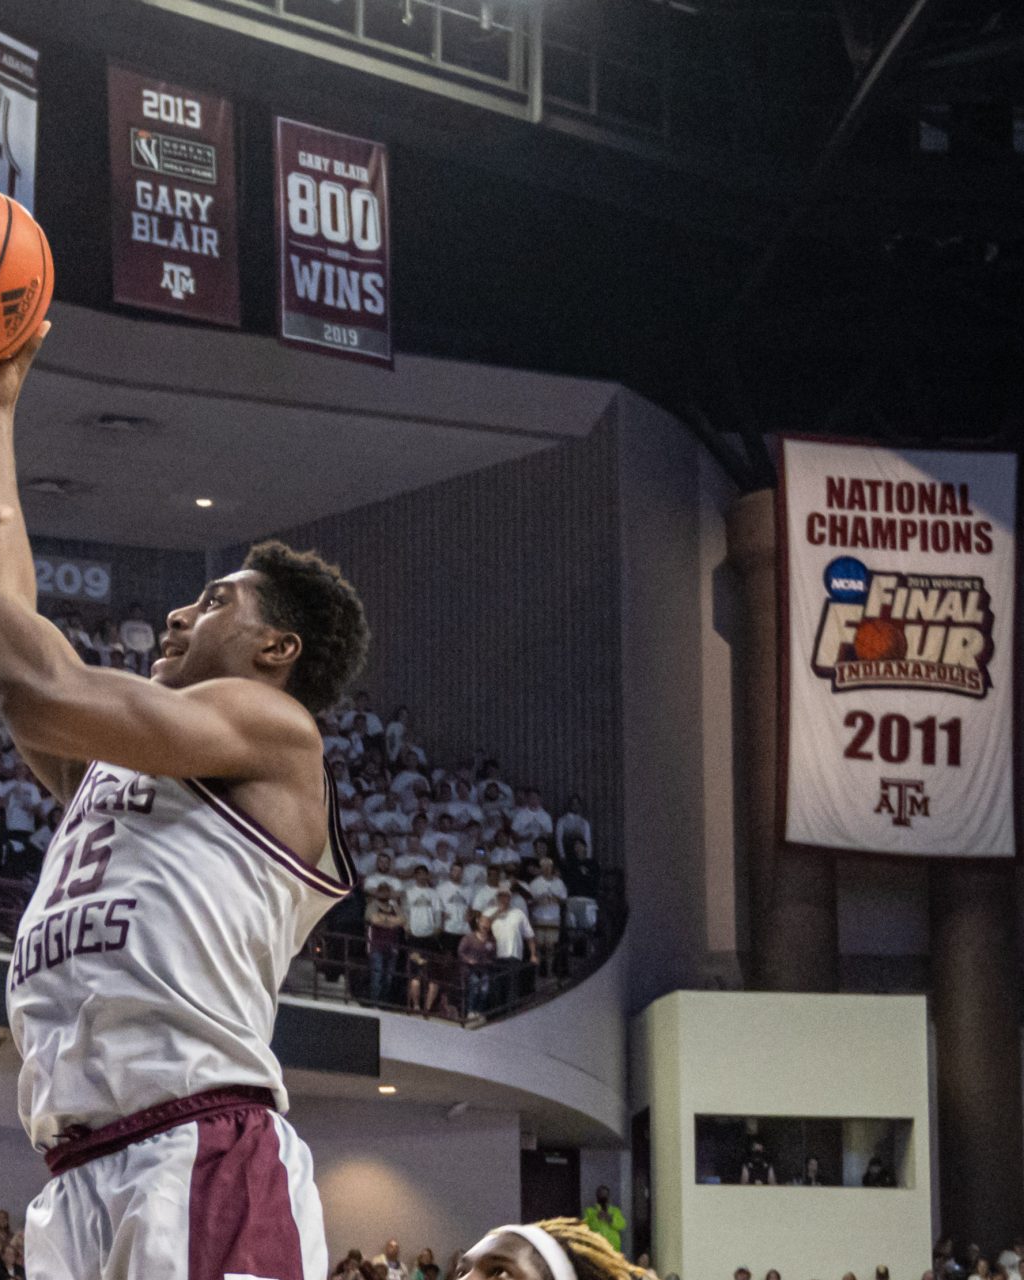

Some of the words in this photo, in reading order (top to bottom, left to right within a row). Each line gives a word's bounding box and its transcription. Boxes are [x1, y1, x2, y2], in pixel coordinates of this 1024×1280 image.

[142, 89, 201, 129] 2013
[298, 150, 330, 173] GARY
[334, 159, 369, 184] BLAIR
[135, 180, 213, 223] GARY
[288, 171, 381, 251] 800
[131, 211, 219, 258] BLAIR
[290, 254, 384, 315] WINS
[324, 323, 359, 347] 2019
[825, 475, 973, 516] NATIONAL
[805, 511, 995, 556] CHAMPIONS
[35, 558, 110, 599] 209
[865, 574, 985, 625] FINAL
[836, 660, 981, 691] INDIANAPOLIS
[843, 710, 963, 768] 2011
[45, 819, 116, 910] 15
[10, 899, 137, 992] AGGIES
